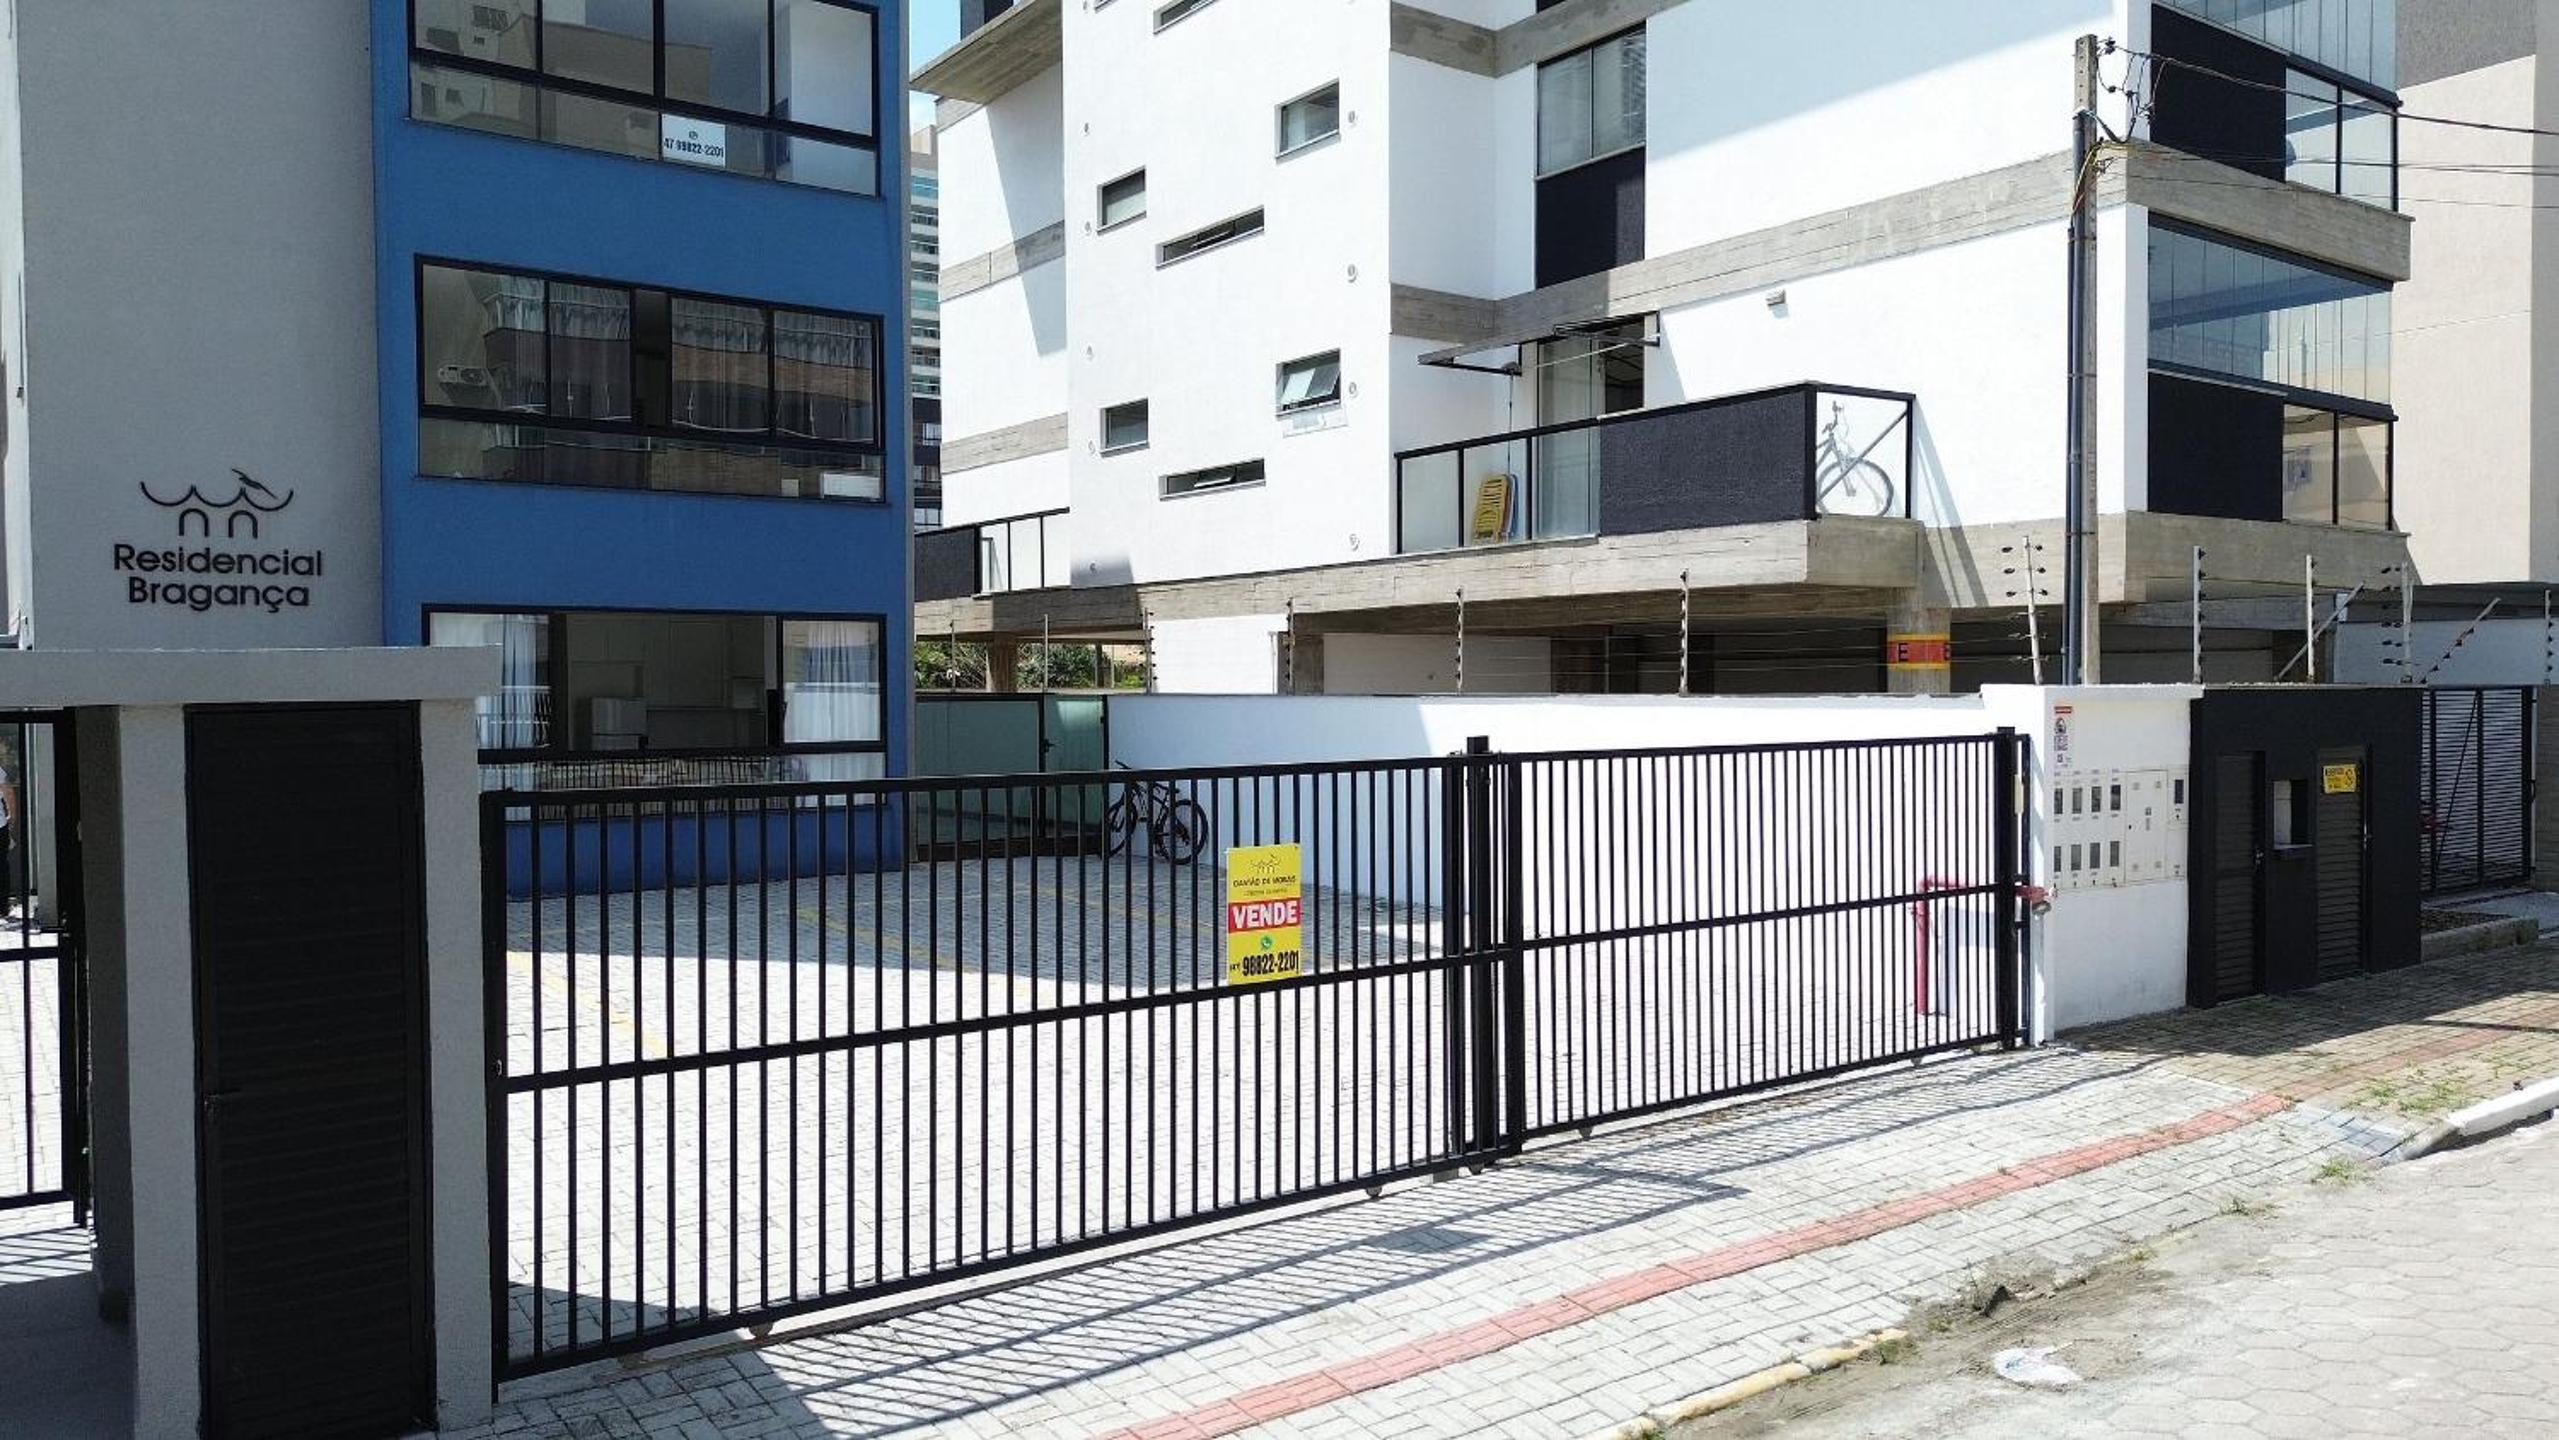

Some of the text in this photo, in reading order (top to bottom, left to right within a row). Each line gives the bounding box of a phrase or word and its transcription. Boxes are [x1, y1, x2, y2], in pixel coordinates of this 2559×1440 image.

[113, 543, 322, 576] Residencial
[128, 576, 310, 613] Bragança
[1233, 901, 1298, 929] VENDE
[1242, 951, 1299, 976] 98822-2201
